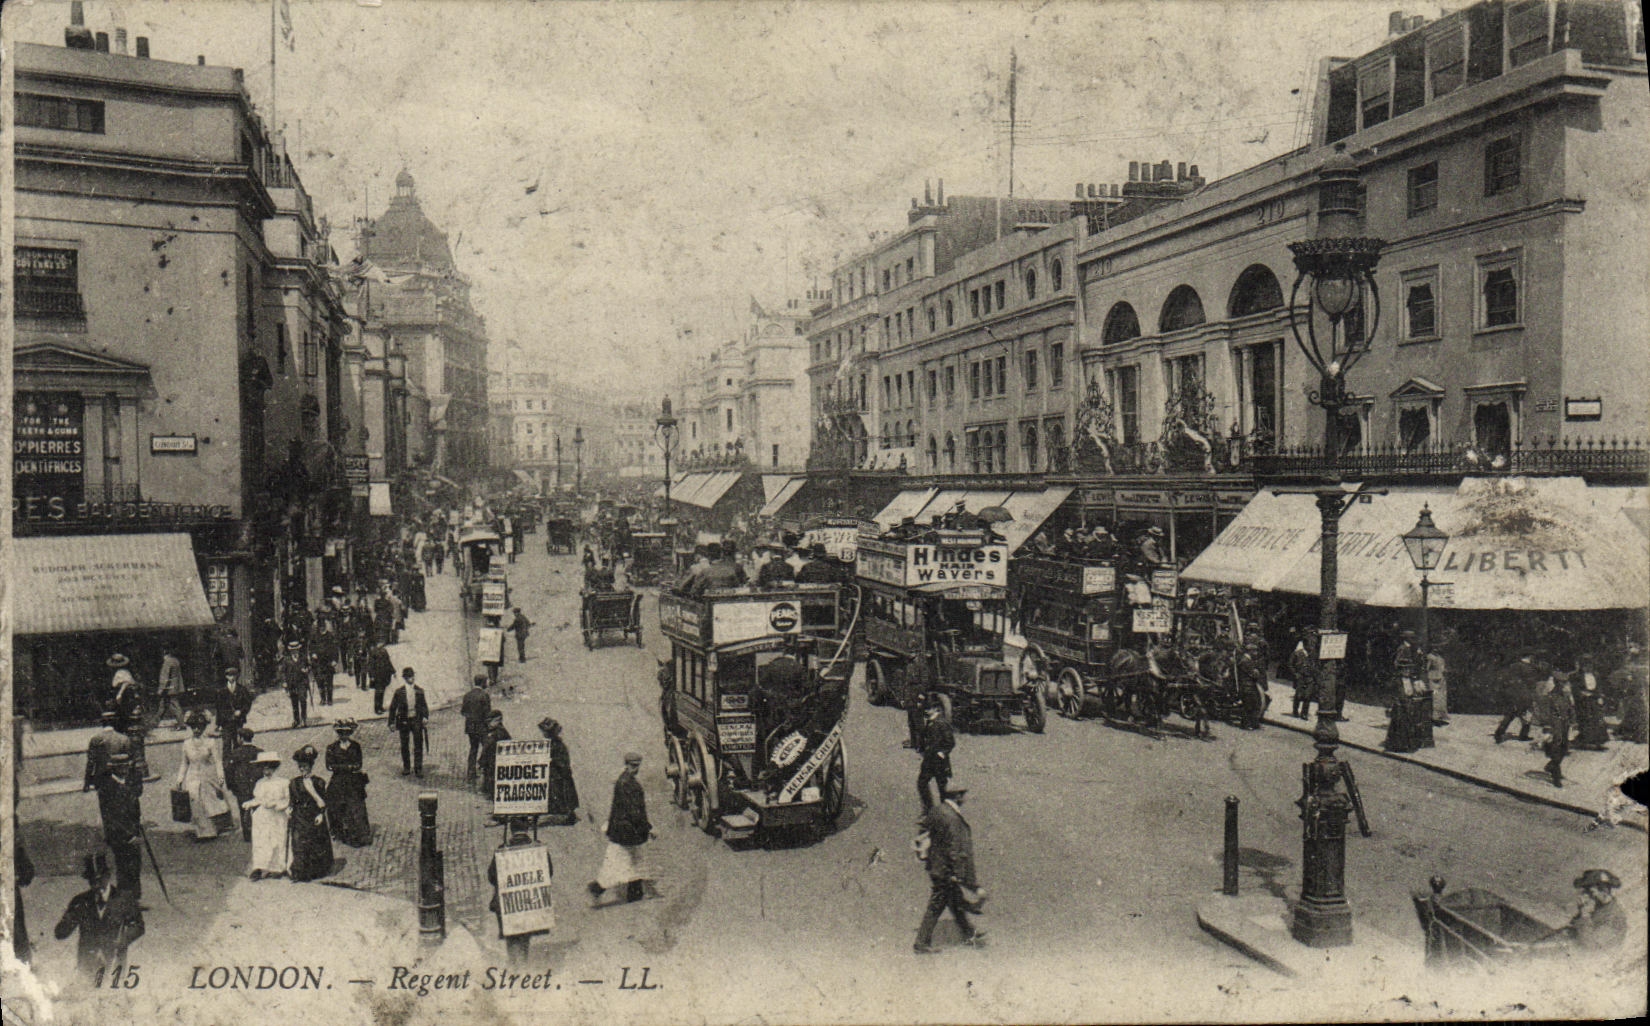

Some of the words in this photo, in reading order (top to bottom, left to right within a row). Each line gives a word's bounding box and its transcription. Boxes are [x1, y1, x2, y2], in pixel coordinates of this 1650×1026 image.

[28, 440, 81, 454] PIERRE'S
[15, 459, 82, 474] DENTIFRICES
[914, 548, 1001, 565] Hindes
[1443, 548, 1588, 573] LIBERTY
[918, 569, 995, 582] Wavers
[785, 760, 816, 795] KENSAL
[814, 730, 839, 761] GREEN
[496, 764, 548, 780] BUDGET
[495, 783, 547, 802] FRAGSON
[506, 869, 544, 888] ADELE
